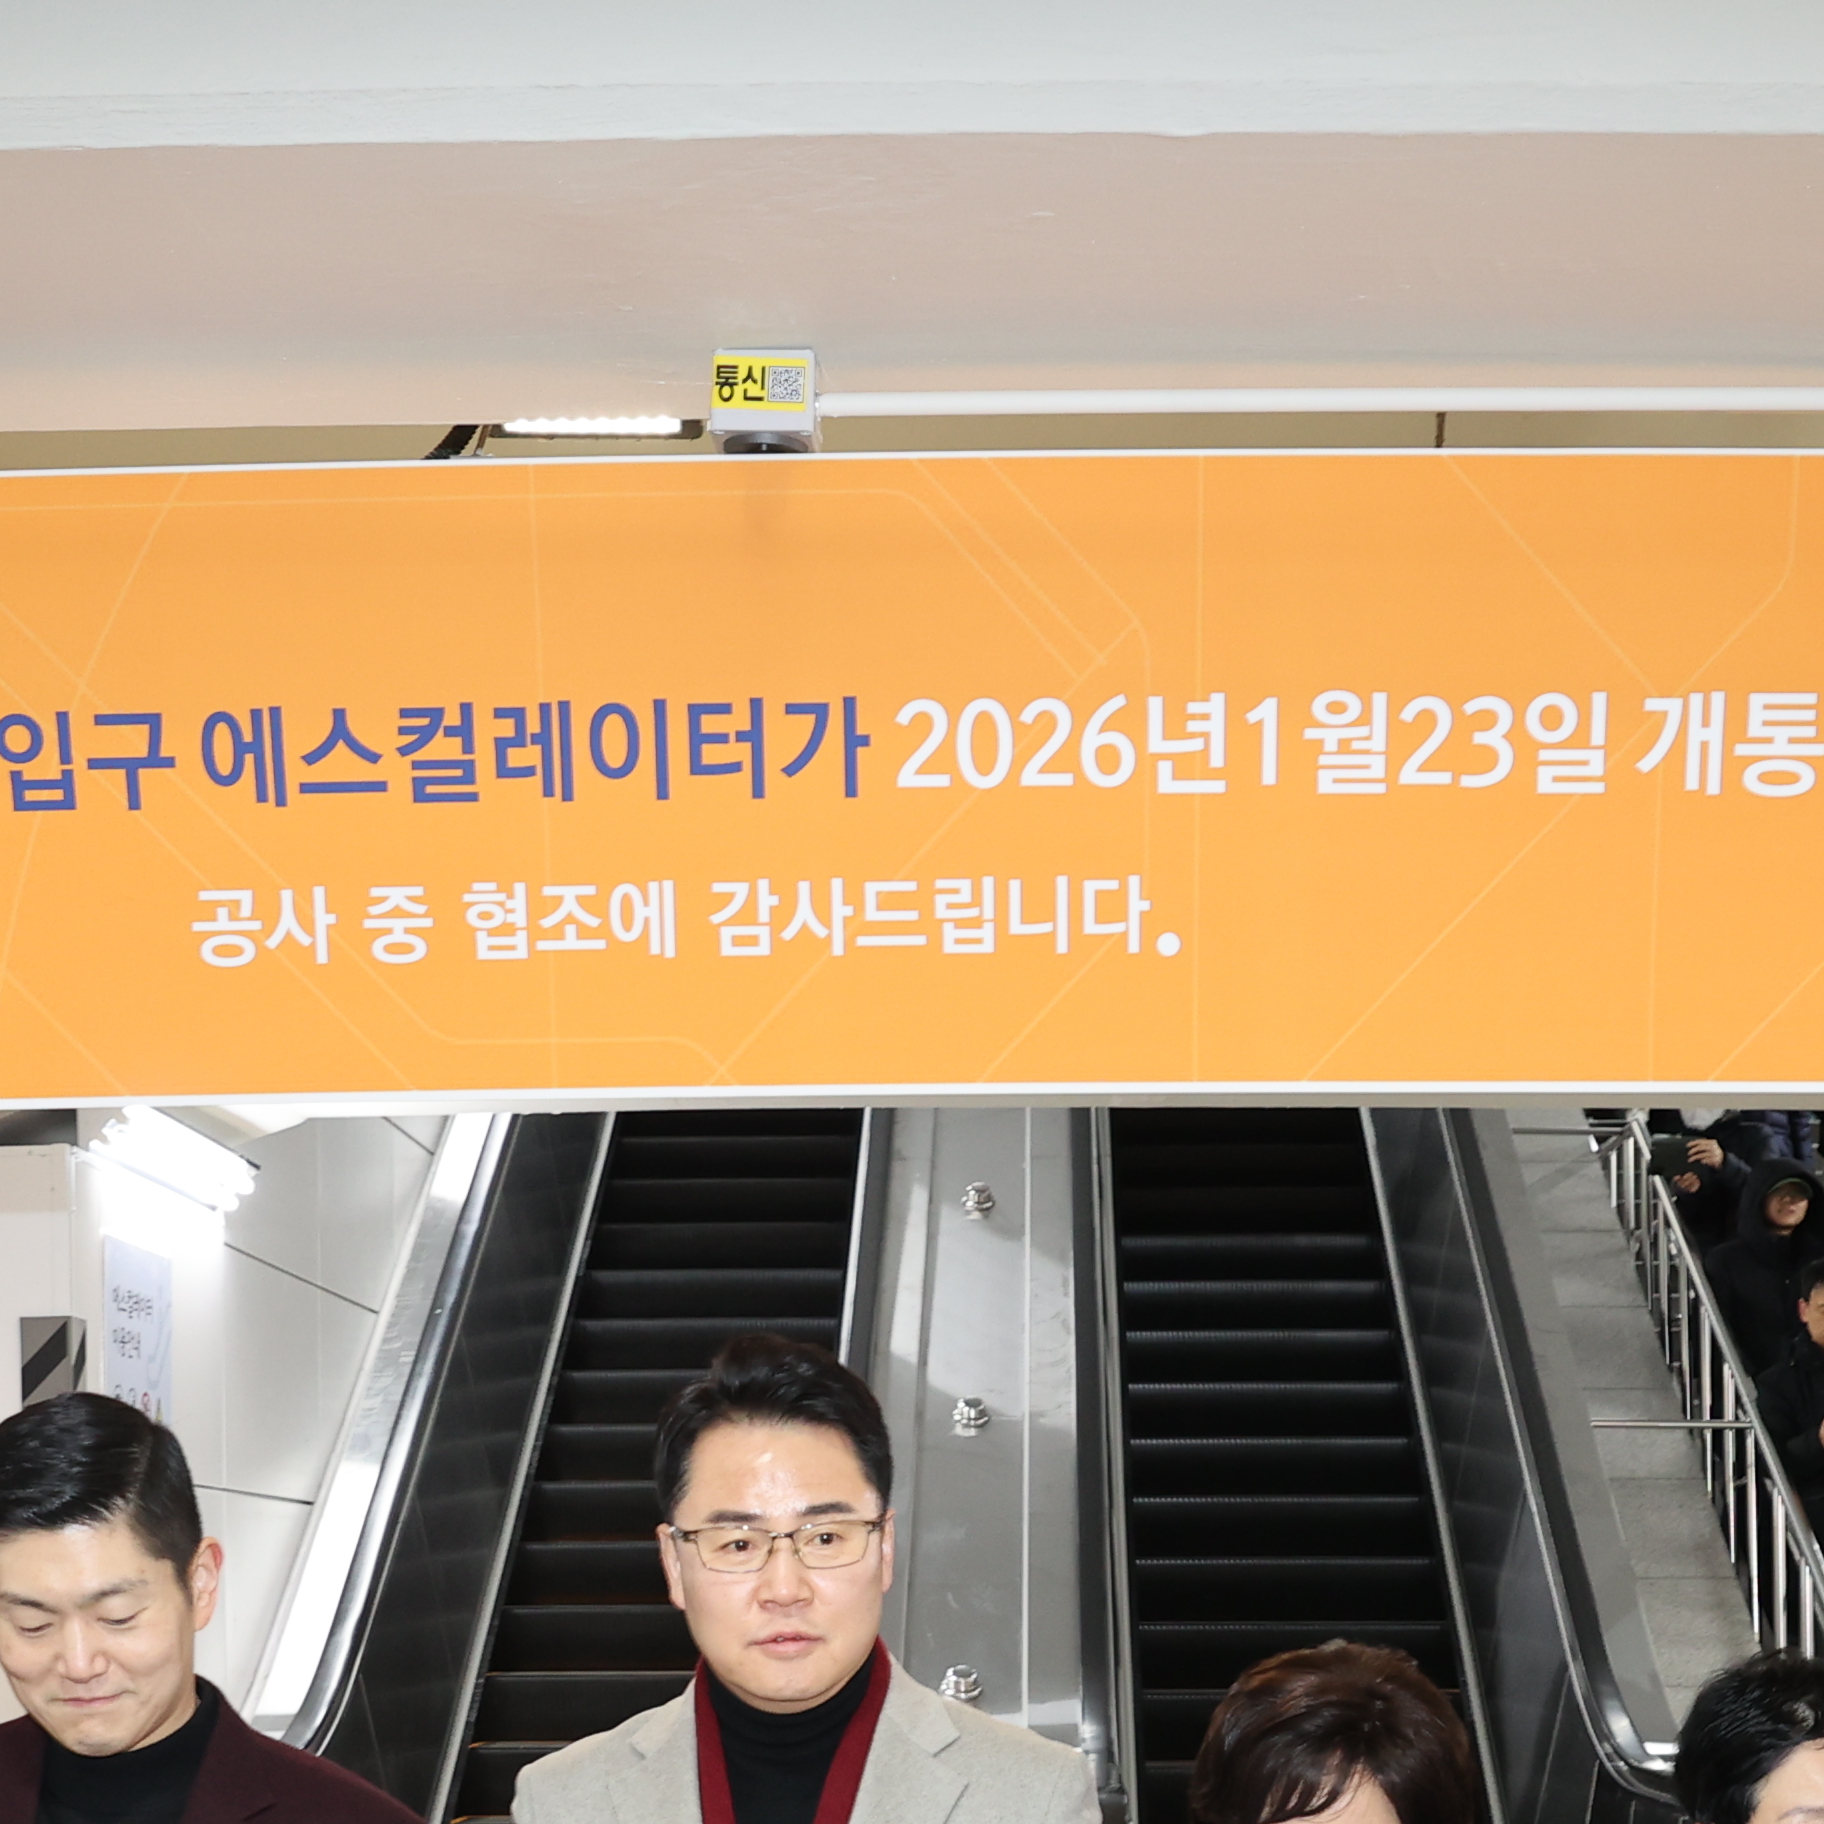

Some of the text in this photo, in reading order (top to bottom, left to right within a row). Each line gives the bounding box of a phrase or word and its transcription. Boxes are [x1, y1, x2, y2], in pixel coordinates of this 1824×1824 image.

[714, 364, 766, 403] 통신
[200, 694, 871, 810] 에스컬레이터가
[190, 873, 1182, 968] 공사 중 협조에 감사드립니다.
